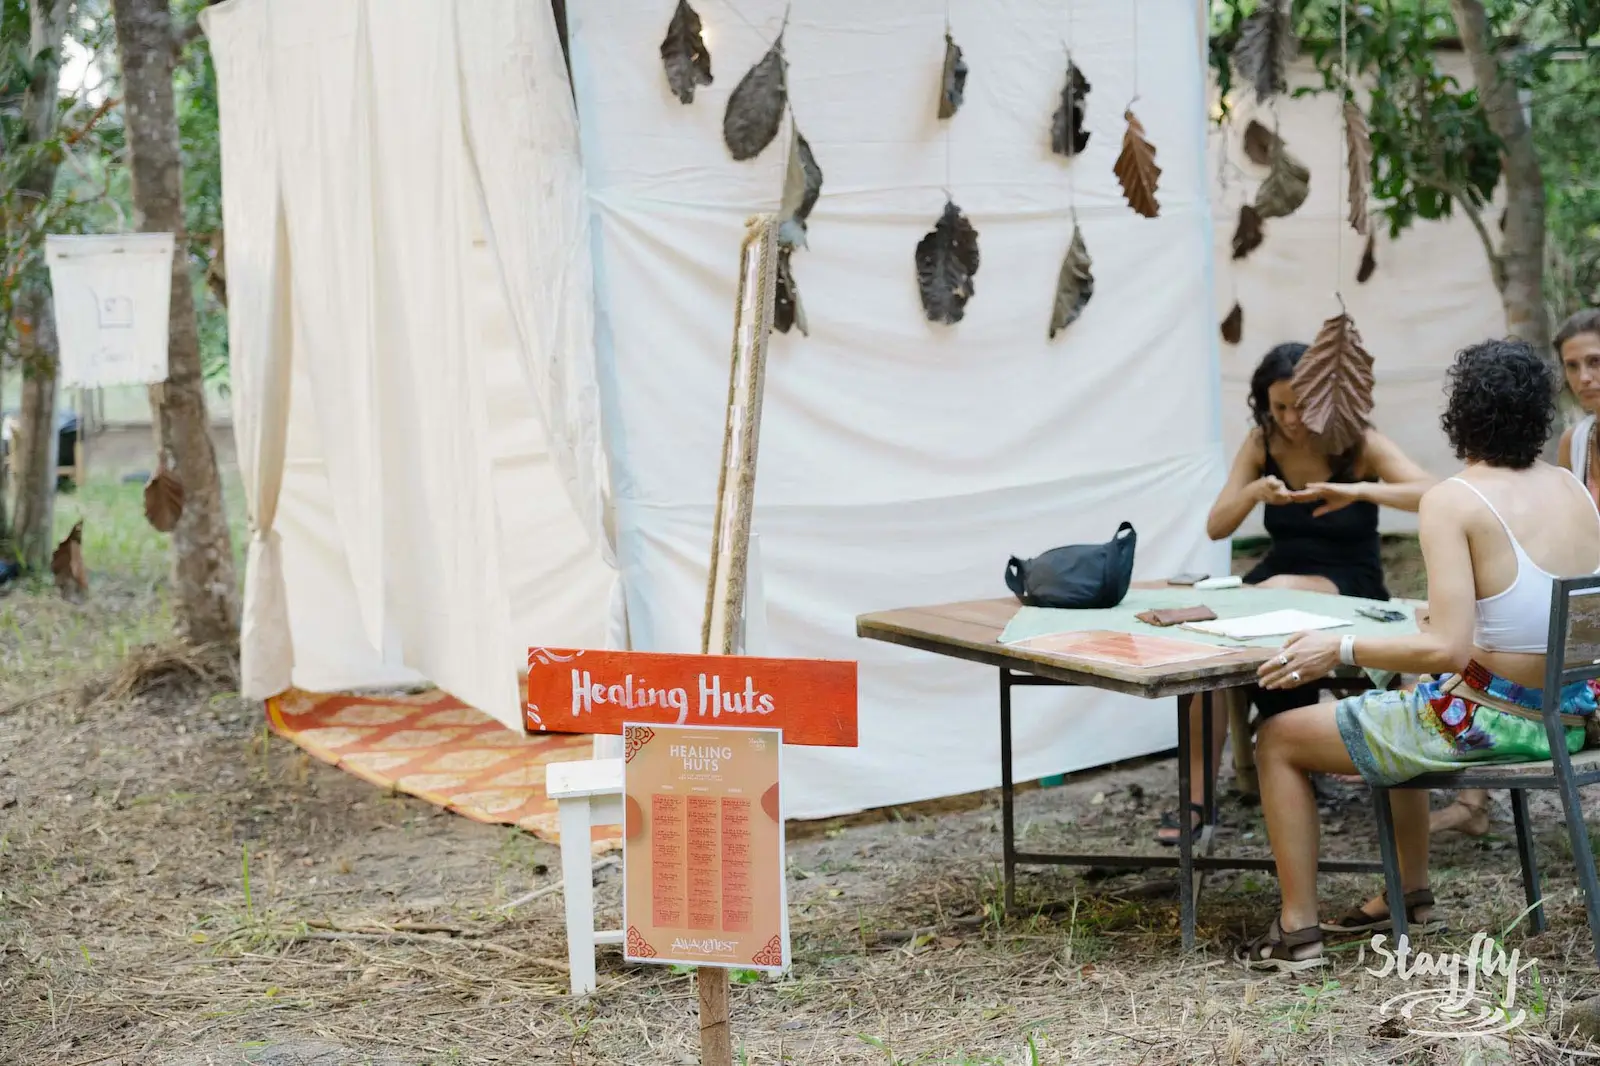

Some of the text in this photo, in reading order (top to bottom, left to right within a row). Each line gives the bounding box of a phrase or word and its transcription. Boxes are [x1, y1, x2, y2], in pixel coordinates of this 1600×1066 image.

[571, 668, 775, 725] Healing Huts
[669, 744, 733, 760] HEALING
[683, 758, 719, 772] HUTS
